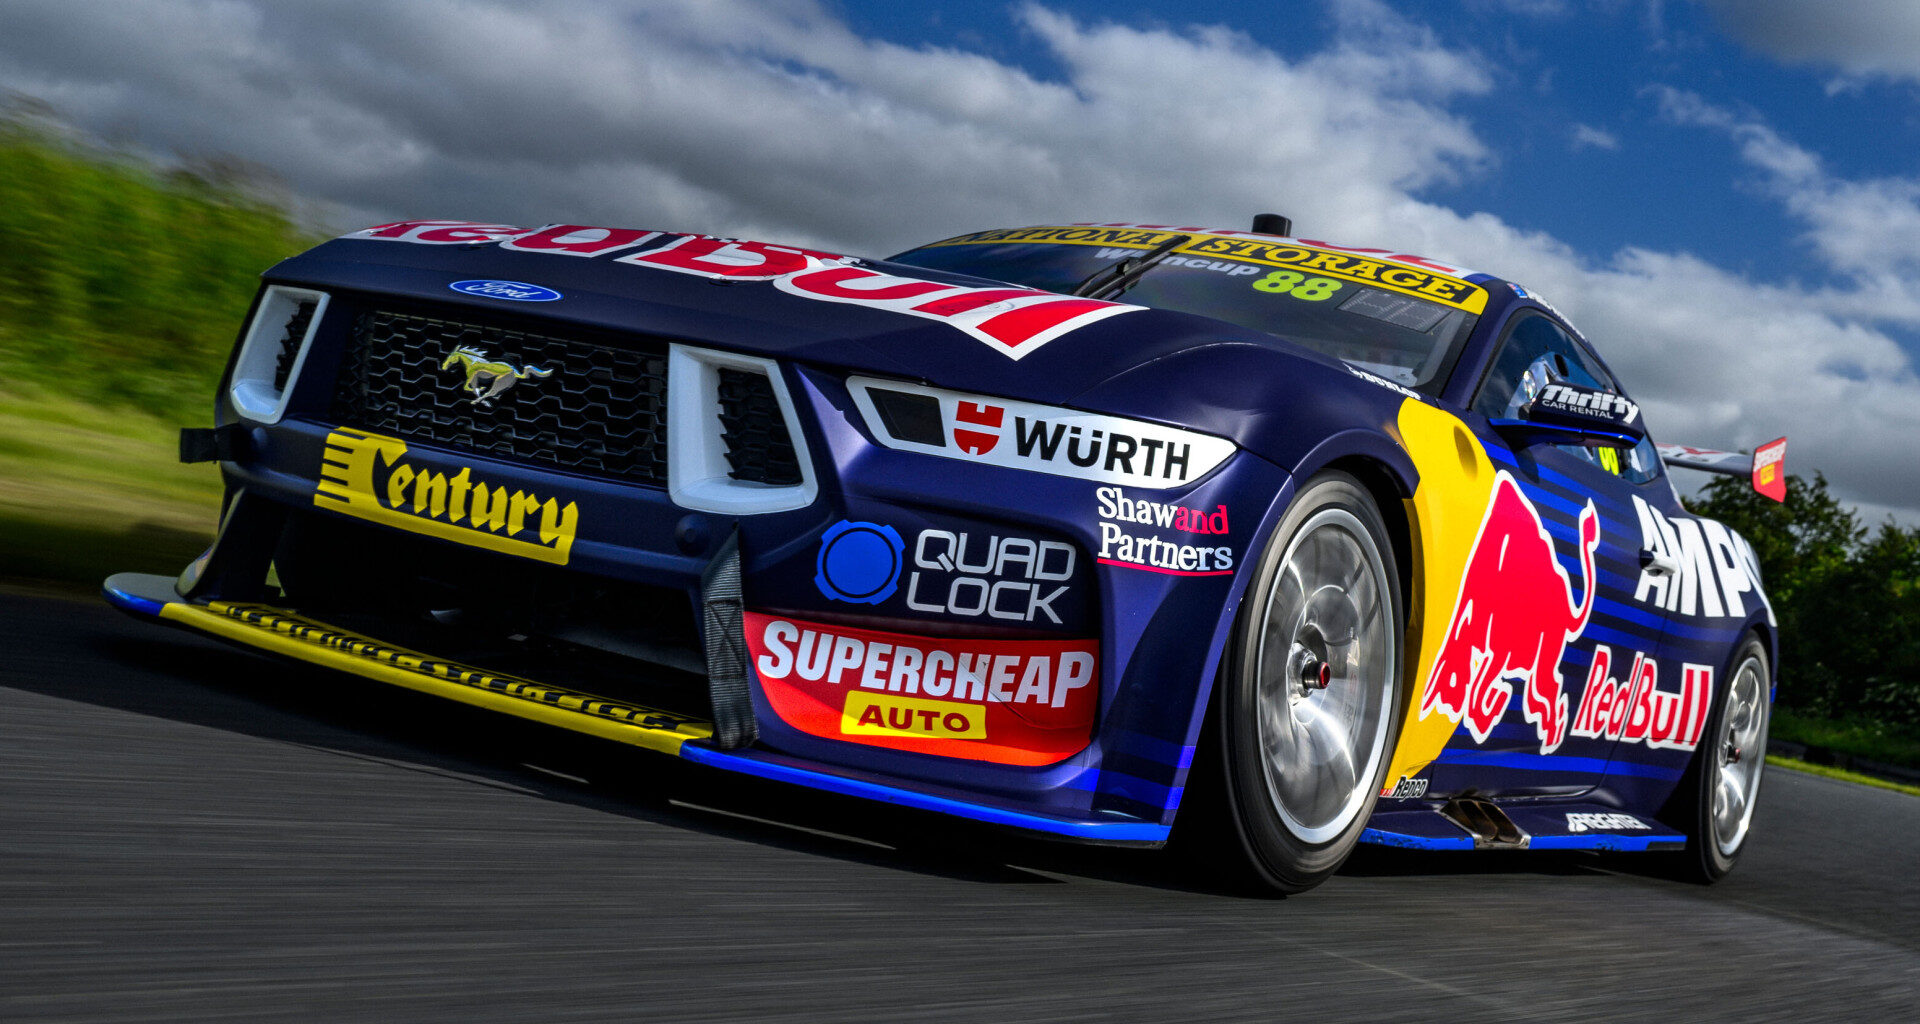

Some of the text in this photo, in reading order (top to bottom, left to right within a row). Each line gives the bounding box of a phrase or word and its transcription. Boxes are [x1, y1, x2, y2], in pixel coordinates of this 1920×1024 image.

[1095, 247, 1261, 276] Wncup
[1200, 238, 1463, 300] STORAGE
[465, 282, 542, 299] Ford
[1252, 271, 1343, 301] 88
[1541, 400, 1614, 420] CAR RENTAL
[1543, 384, 1639, 424] Thrifty
[1014, 416, 1191, 481] WÜRTH
[315, 427, 579, 565] Century
[914, 529, 1077, 582] QUAD
[1096, 521, 1233, 571] Partners
[906, 571, 1071, 625] LOCK
[757, 620, 1095, 708] SUPERCHEAP
[857, 704, 971, 733] AUTO
[1391, 775, 1428, 801] Repco
